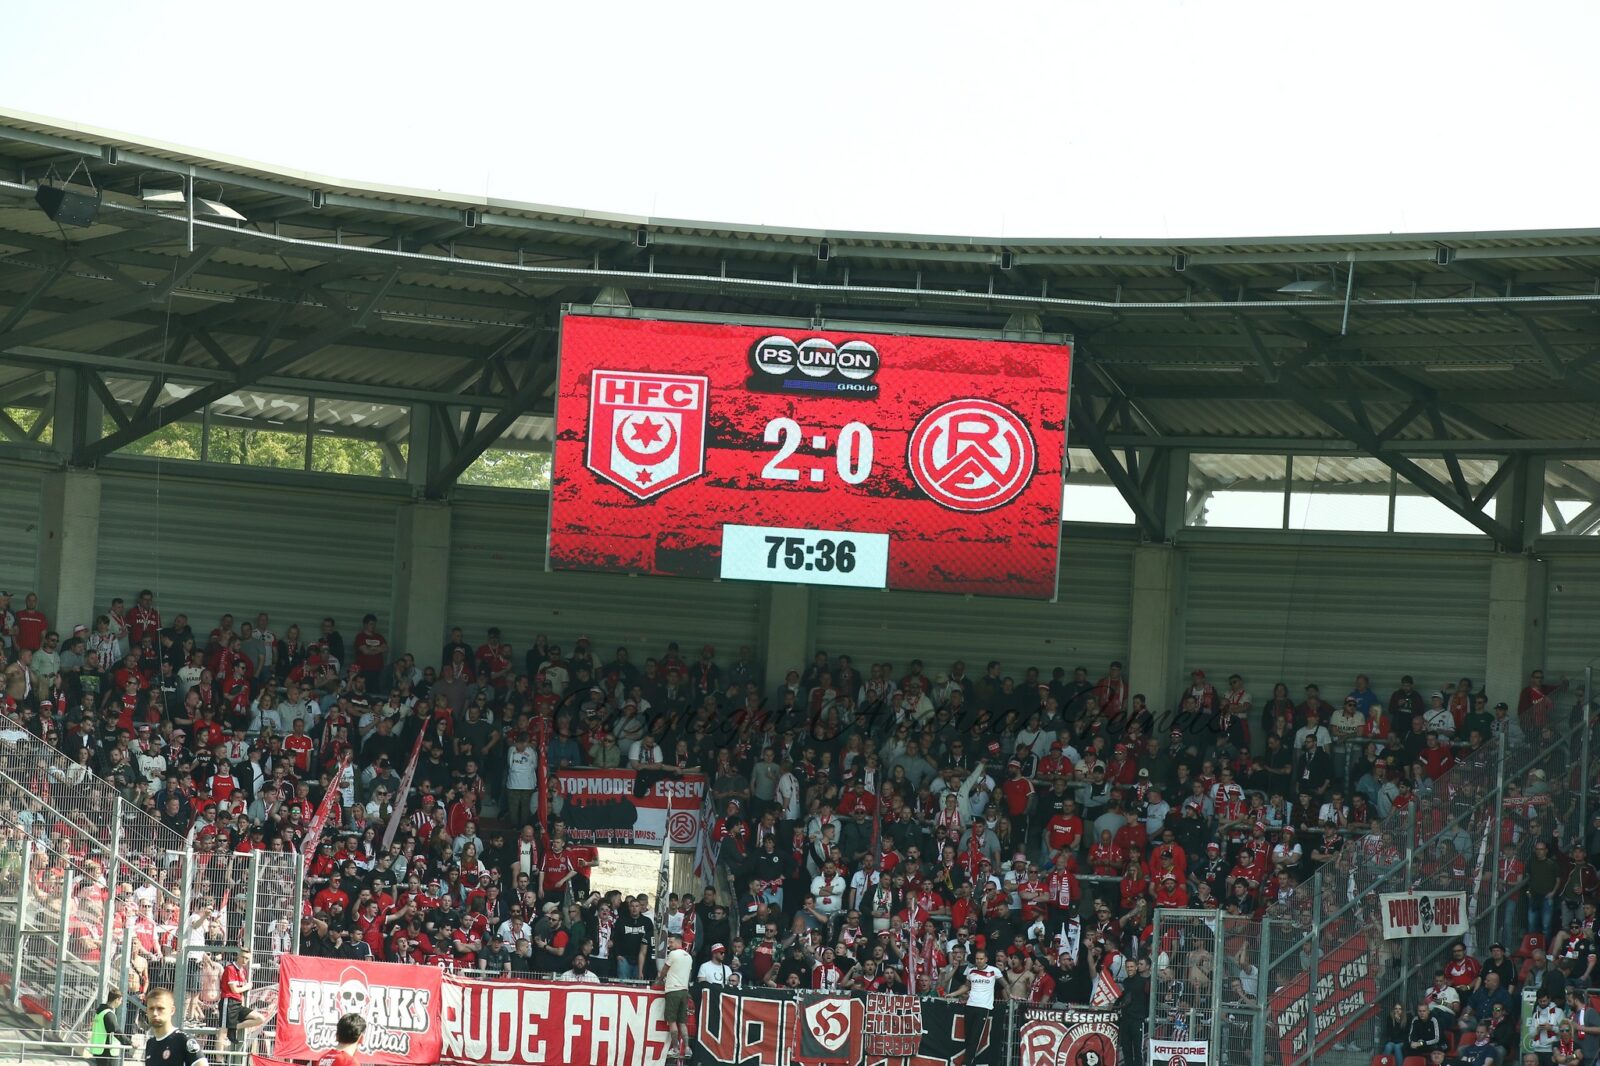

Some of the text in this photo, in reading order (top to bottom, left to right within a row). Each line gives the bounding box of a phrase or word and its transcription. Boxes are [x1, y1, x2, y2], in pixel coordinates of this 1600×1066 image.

[763, 348, 870, 367] PS UNION
[605, 380, 692, 407] HFC
[837, 383, 877, 391] GROUP
[761, 417, 873, 484] 2:0
[765, 535, 856, 573] 75:36
[559, 777, 705, 798] TOPMODE ESSEN
[288, 980, 430, 1032] FREAKS
[866, 994, 921, 1014] GRUPPE
[440, 982, 550, 1063] RUDE
[563, 991, 669, 1066] FANS
[1025, 1009, 1063, 1022] JUNGE
[1154, 1045, 1206, 1056] KATEGORIE
